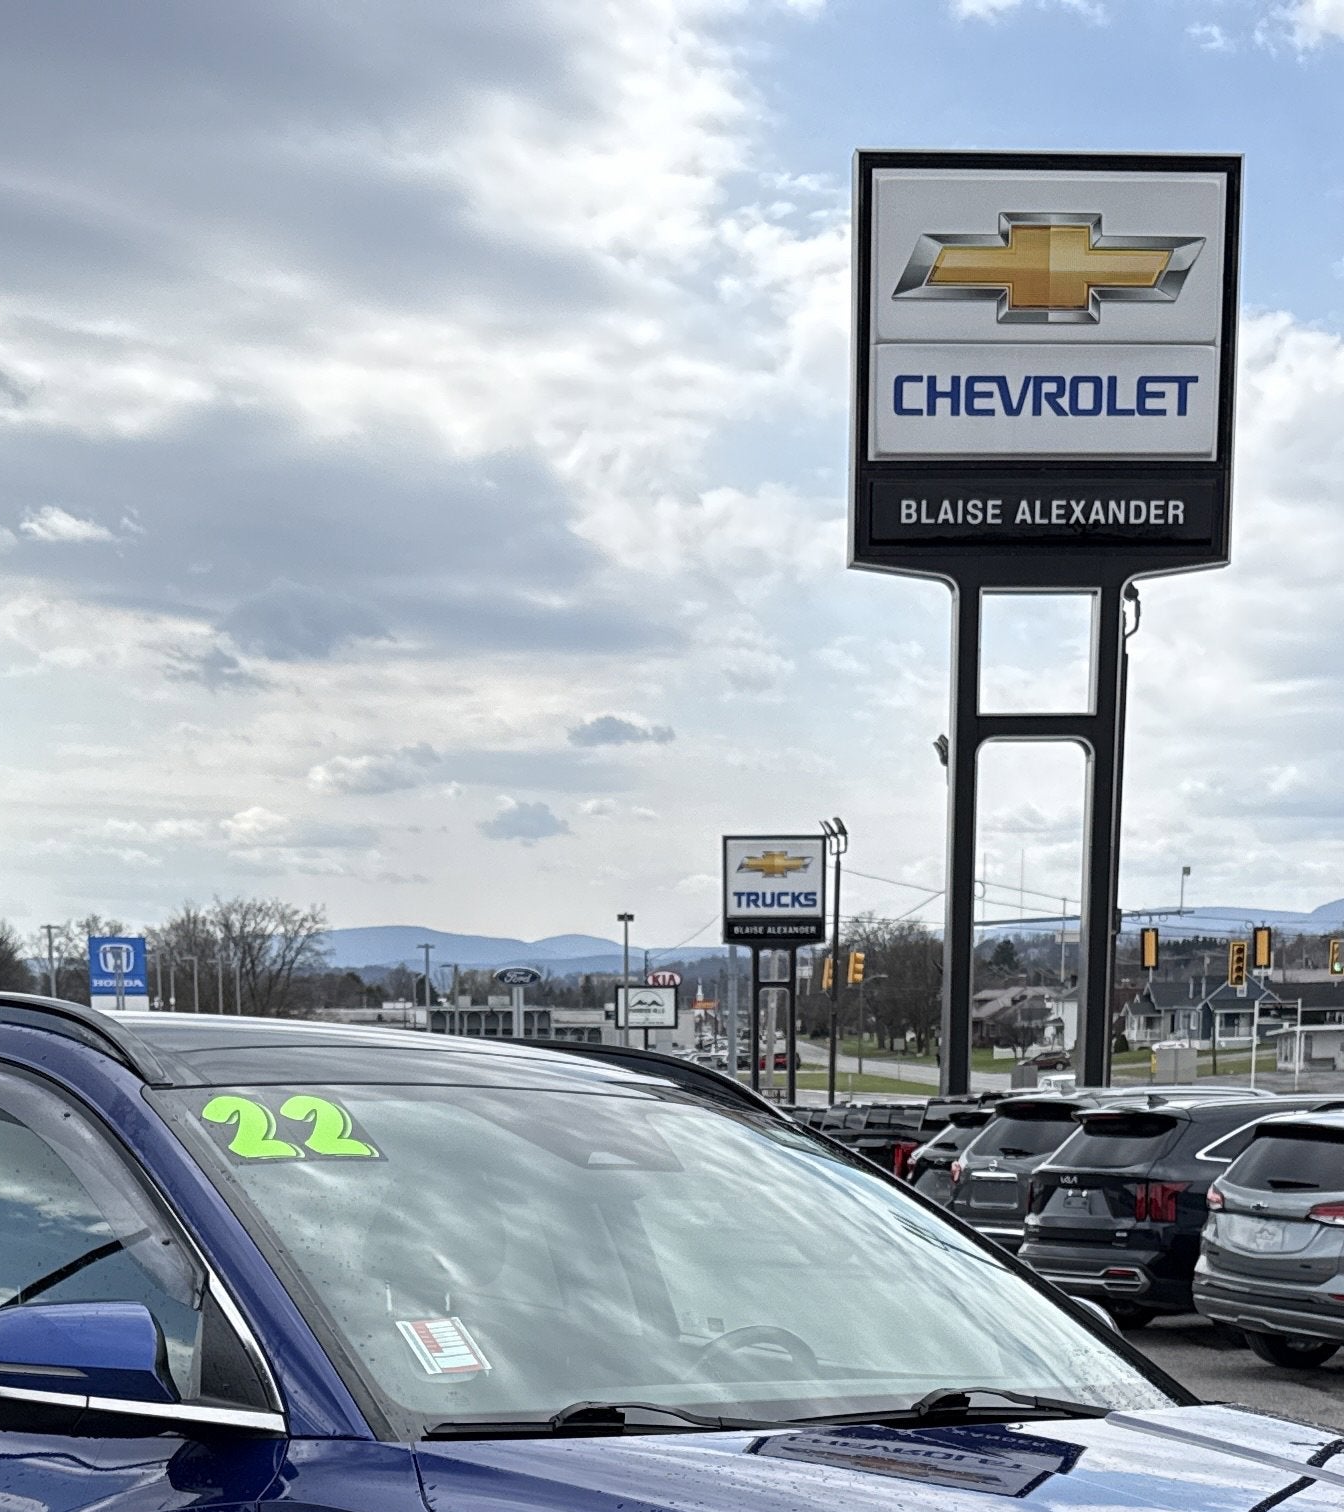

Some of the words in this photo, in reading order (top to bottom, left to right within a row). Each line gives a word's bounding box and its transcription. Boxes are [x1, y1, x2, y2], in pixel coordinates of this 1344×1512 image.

[893, 375, 1199, 417] CHEVROLET
[900, 499, 1003, 525] BLAISE
[1014, 499, 1185, 525] ALEXANDER
[733, 892, 817, 908] TRUCKS
[733, 926, 765, 935] BLAISE
[766, 926, 816, 935] ALEXANDER
[652, 974, 676, 986] KIA
[201, 1095, 380, 1160] 22
